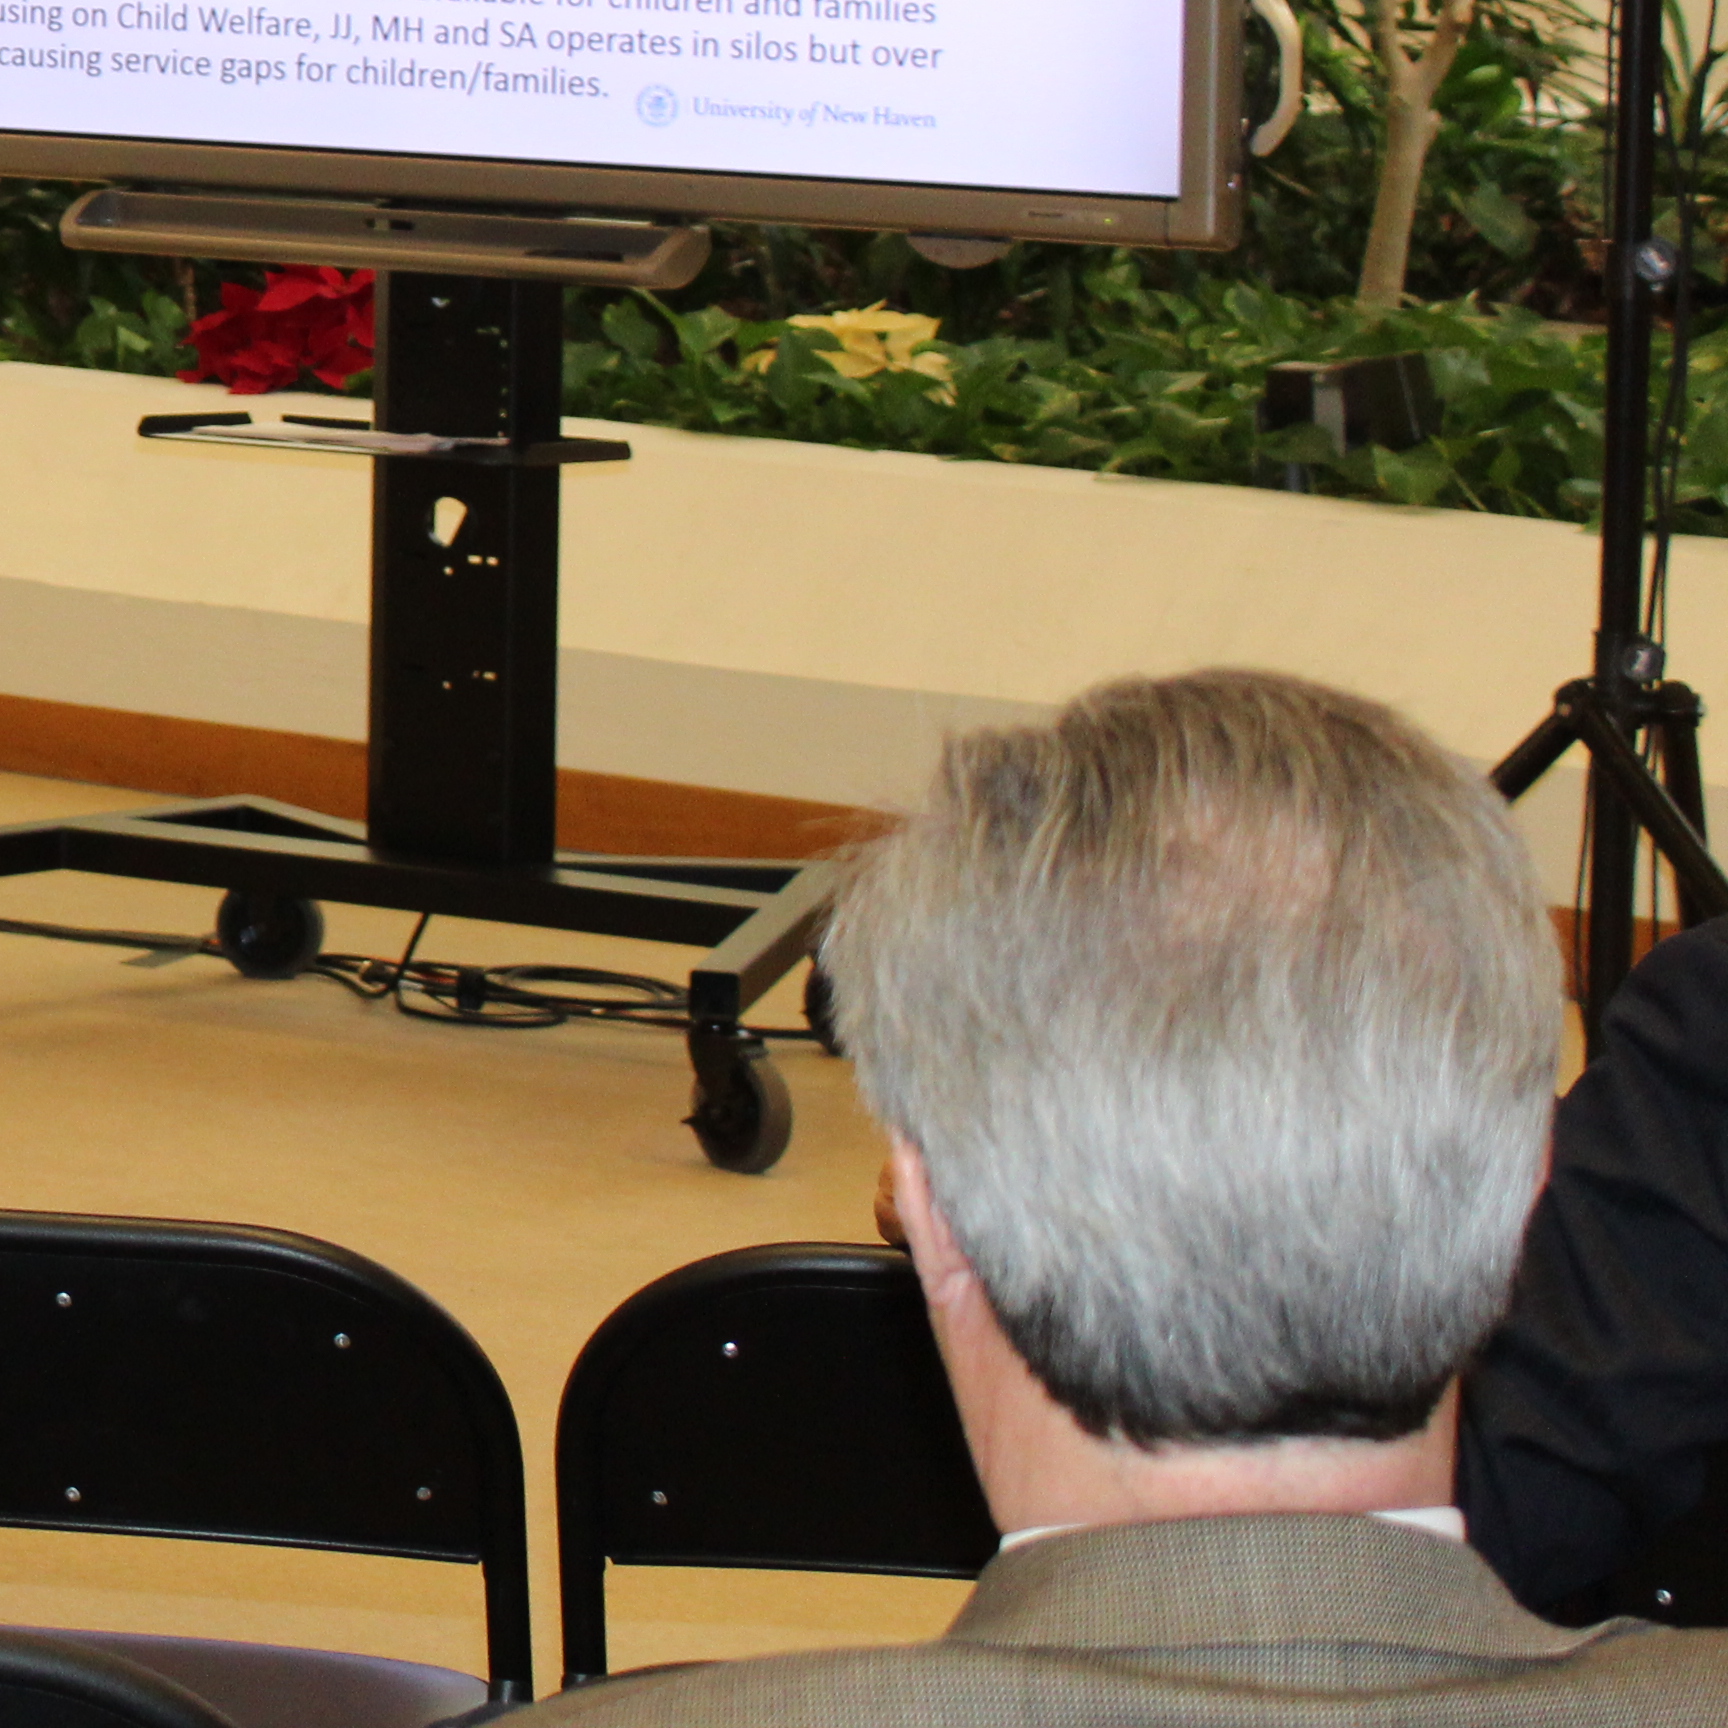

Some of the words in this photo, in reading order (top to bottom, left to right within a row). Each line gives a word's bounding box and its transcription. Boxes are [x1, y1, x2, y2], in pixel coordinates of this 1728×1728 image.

[71, 7, 107, 29] on
[116, 1, 189, 32] Child
[197, 6, 320, 44] Welfare,
[329, 13, 360, 46] JJ,
[371, 14, 423, 44] MH
[433, 18, 490, 48] and
[499, 20, 539, 49] SA
[546, 29, 682, 58] operates
[692, 30, 720, 58] in
[730, 30, 799, 63] silos
[808, 34, 861, 66] but
[872, 45, 943, 69] over
[110, 48, 213, 77] service
[219, 57, 287, 86] gaps
[295, 52, 338, 83] for
[345, 56, 608, 98] children/families.
[692, 96, 795, 123] University
[797, 100, 822, 124] of
[822, 102, 869, 125] New
[872, 105, 937, 129] Haven
